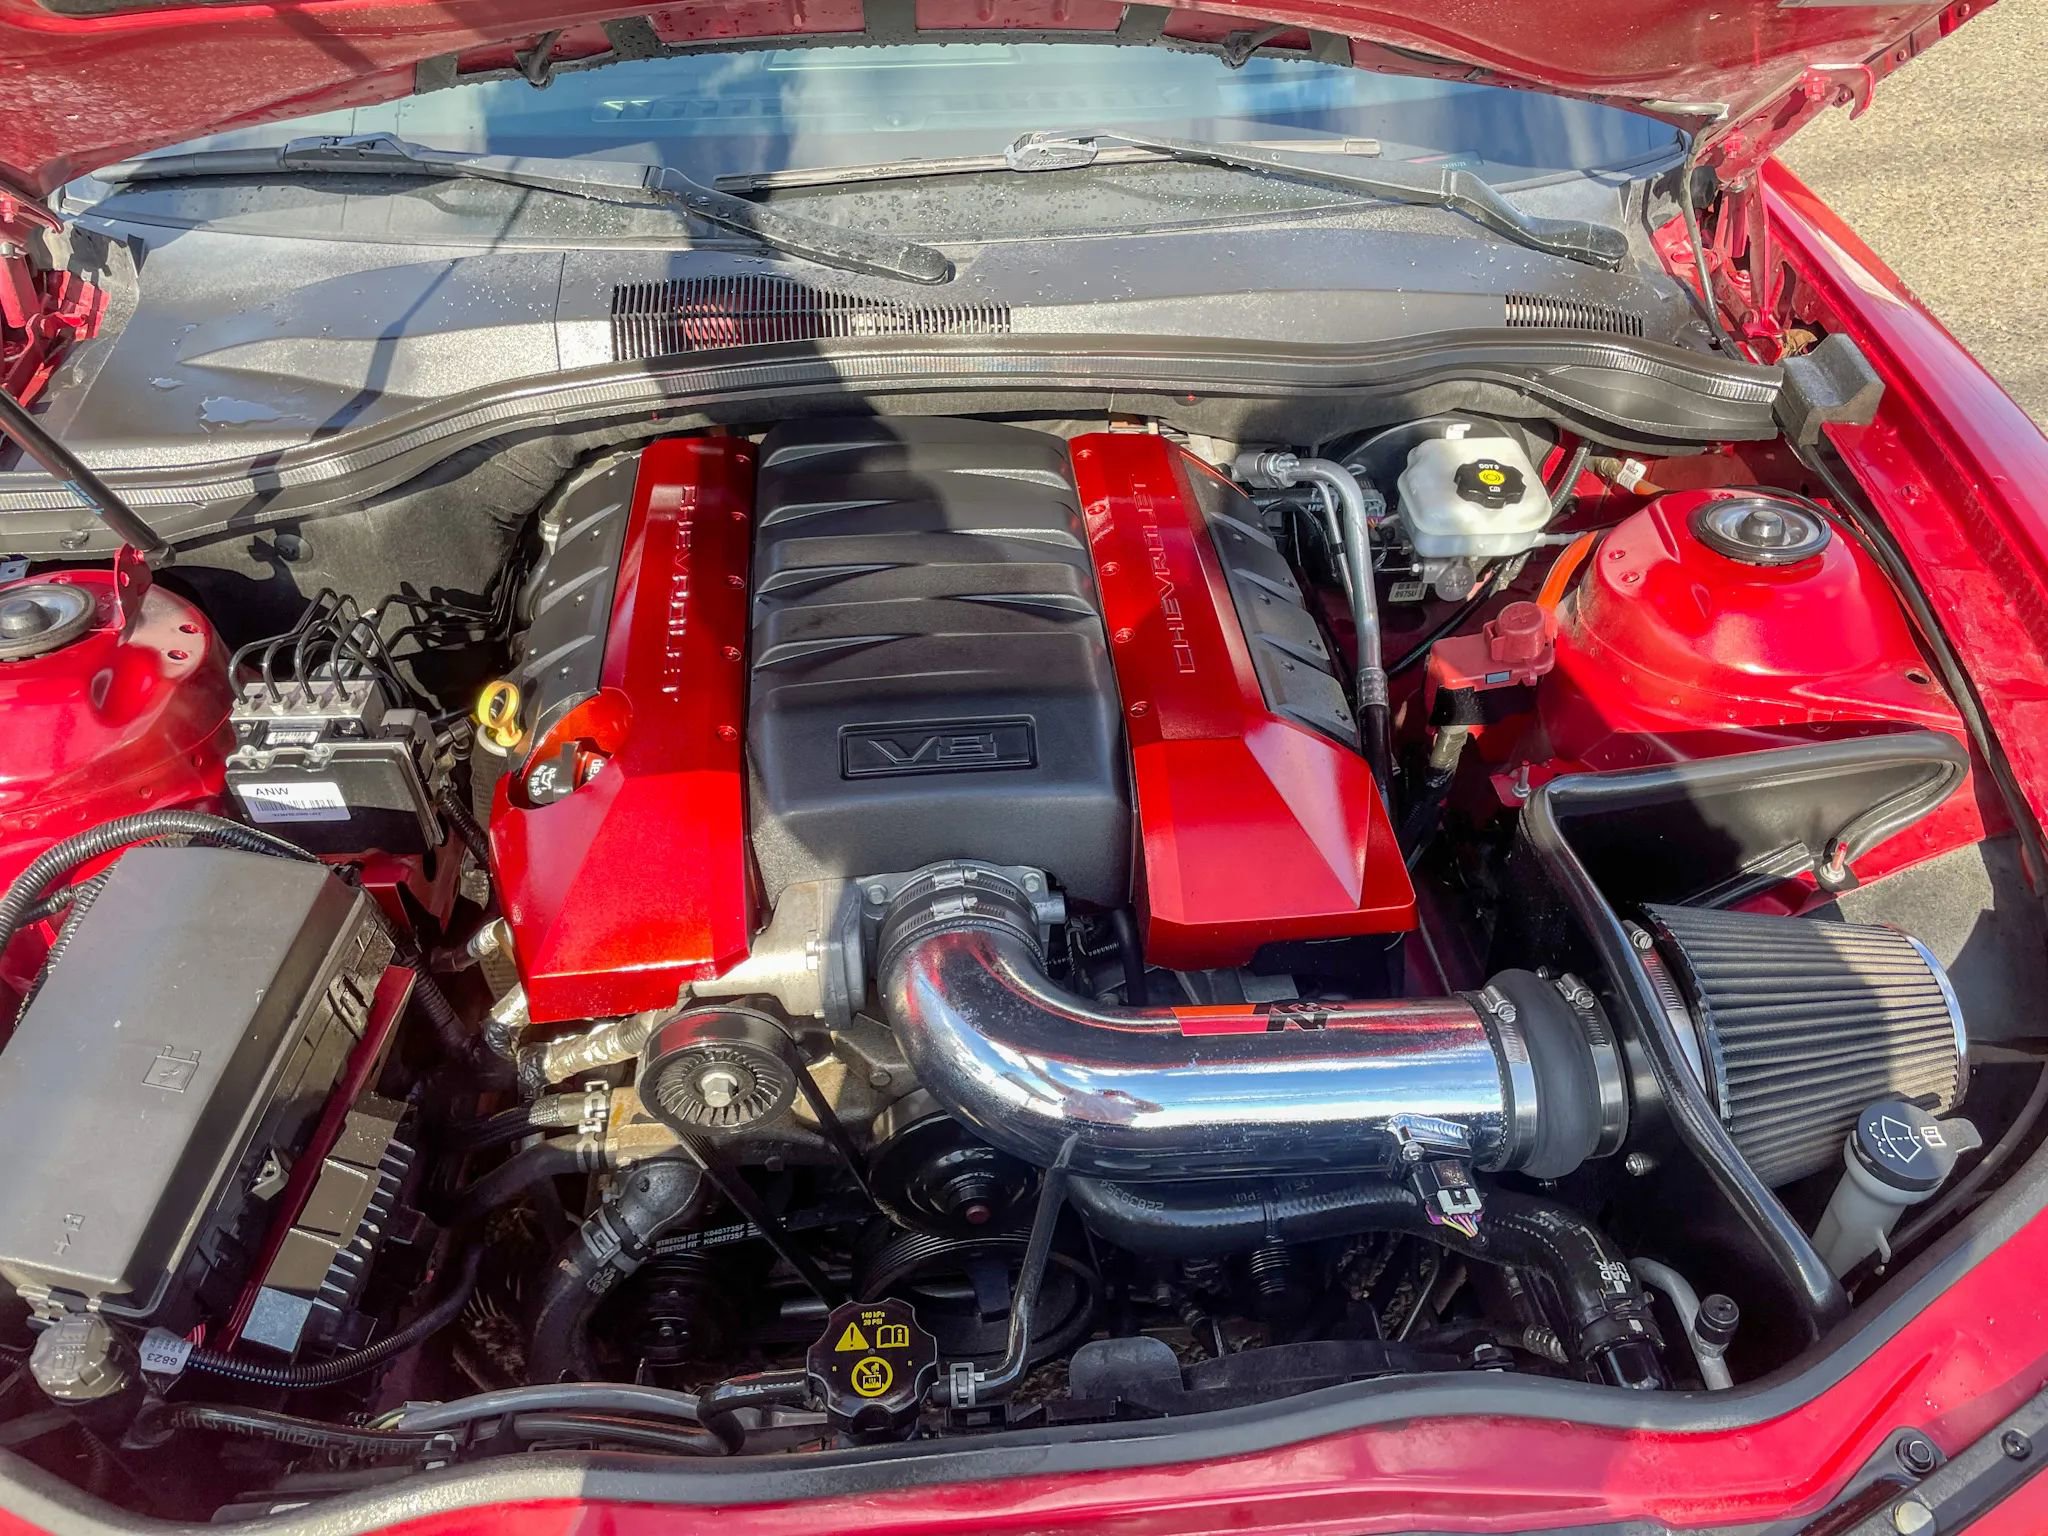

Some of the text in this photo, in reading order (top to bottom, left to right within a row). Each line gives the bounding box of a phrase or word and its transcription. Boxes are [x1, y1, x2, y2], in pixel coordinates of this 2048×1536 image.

[867, 732, 998, 764] V8
[256, 787, 289, 797] ANW
[656, 1236, 687, 1247] STRETCH
[655, 1243, 686, 1255] STRETCH
[1600, 1270, 1632, 1283] RAD
[146, 1352, 178, 1366] 6823
